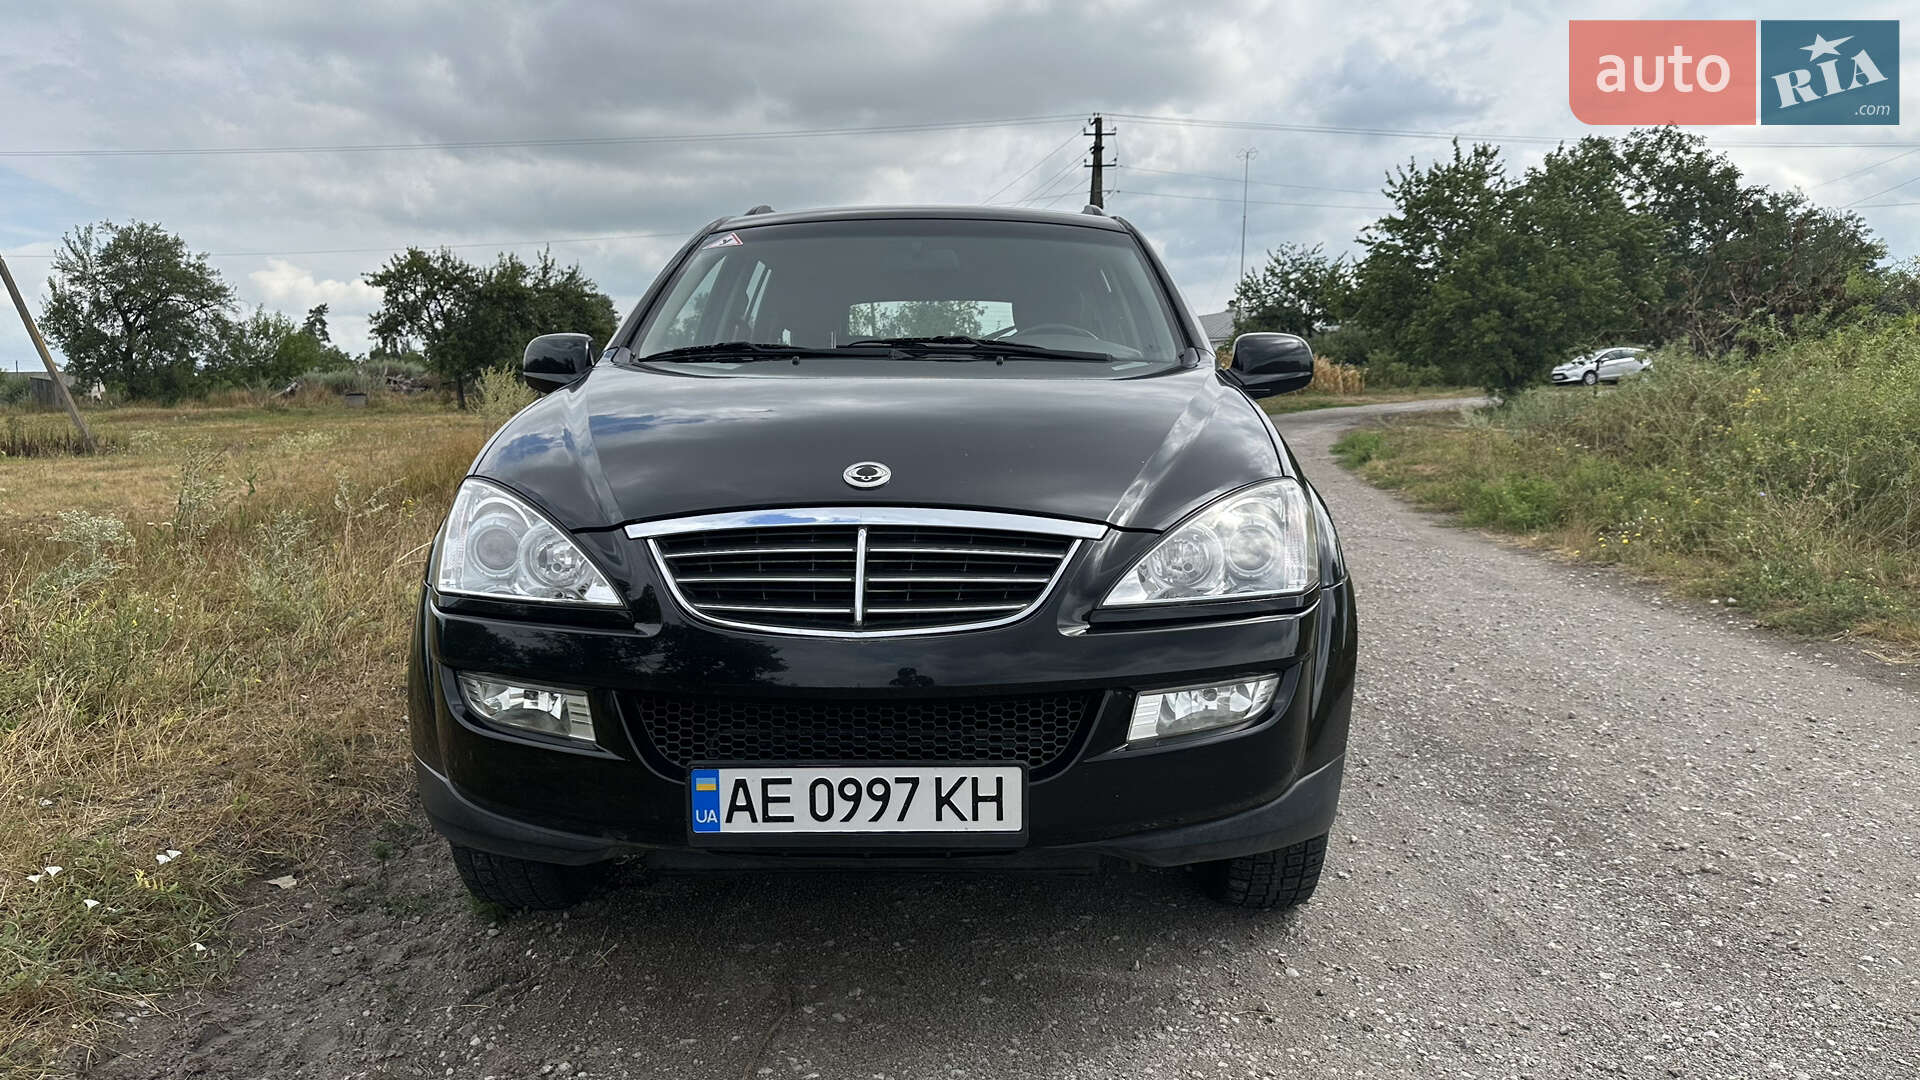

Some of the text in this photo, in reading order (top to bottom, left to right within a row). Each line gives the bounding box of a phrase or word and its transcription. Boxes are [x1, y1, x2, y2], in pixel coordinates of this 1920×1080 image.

[725, 776, 1004, 823] AE 0997 KH
[695, 809, 718, 823] UA
